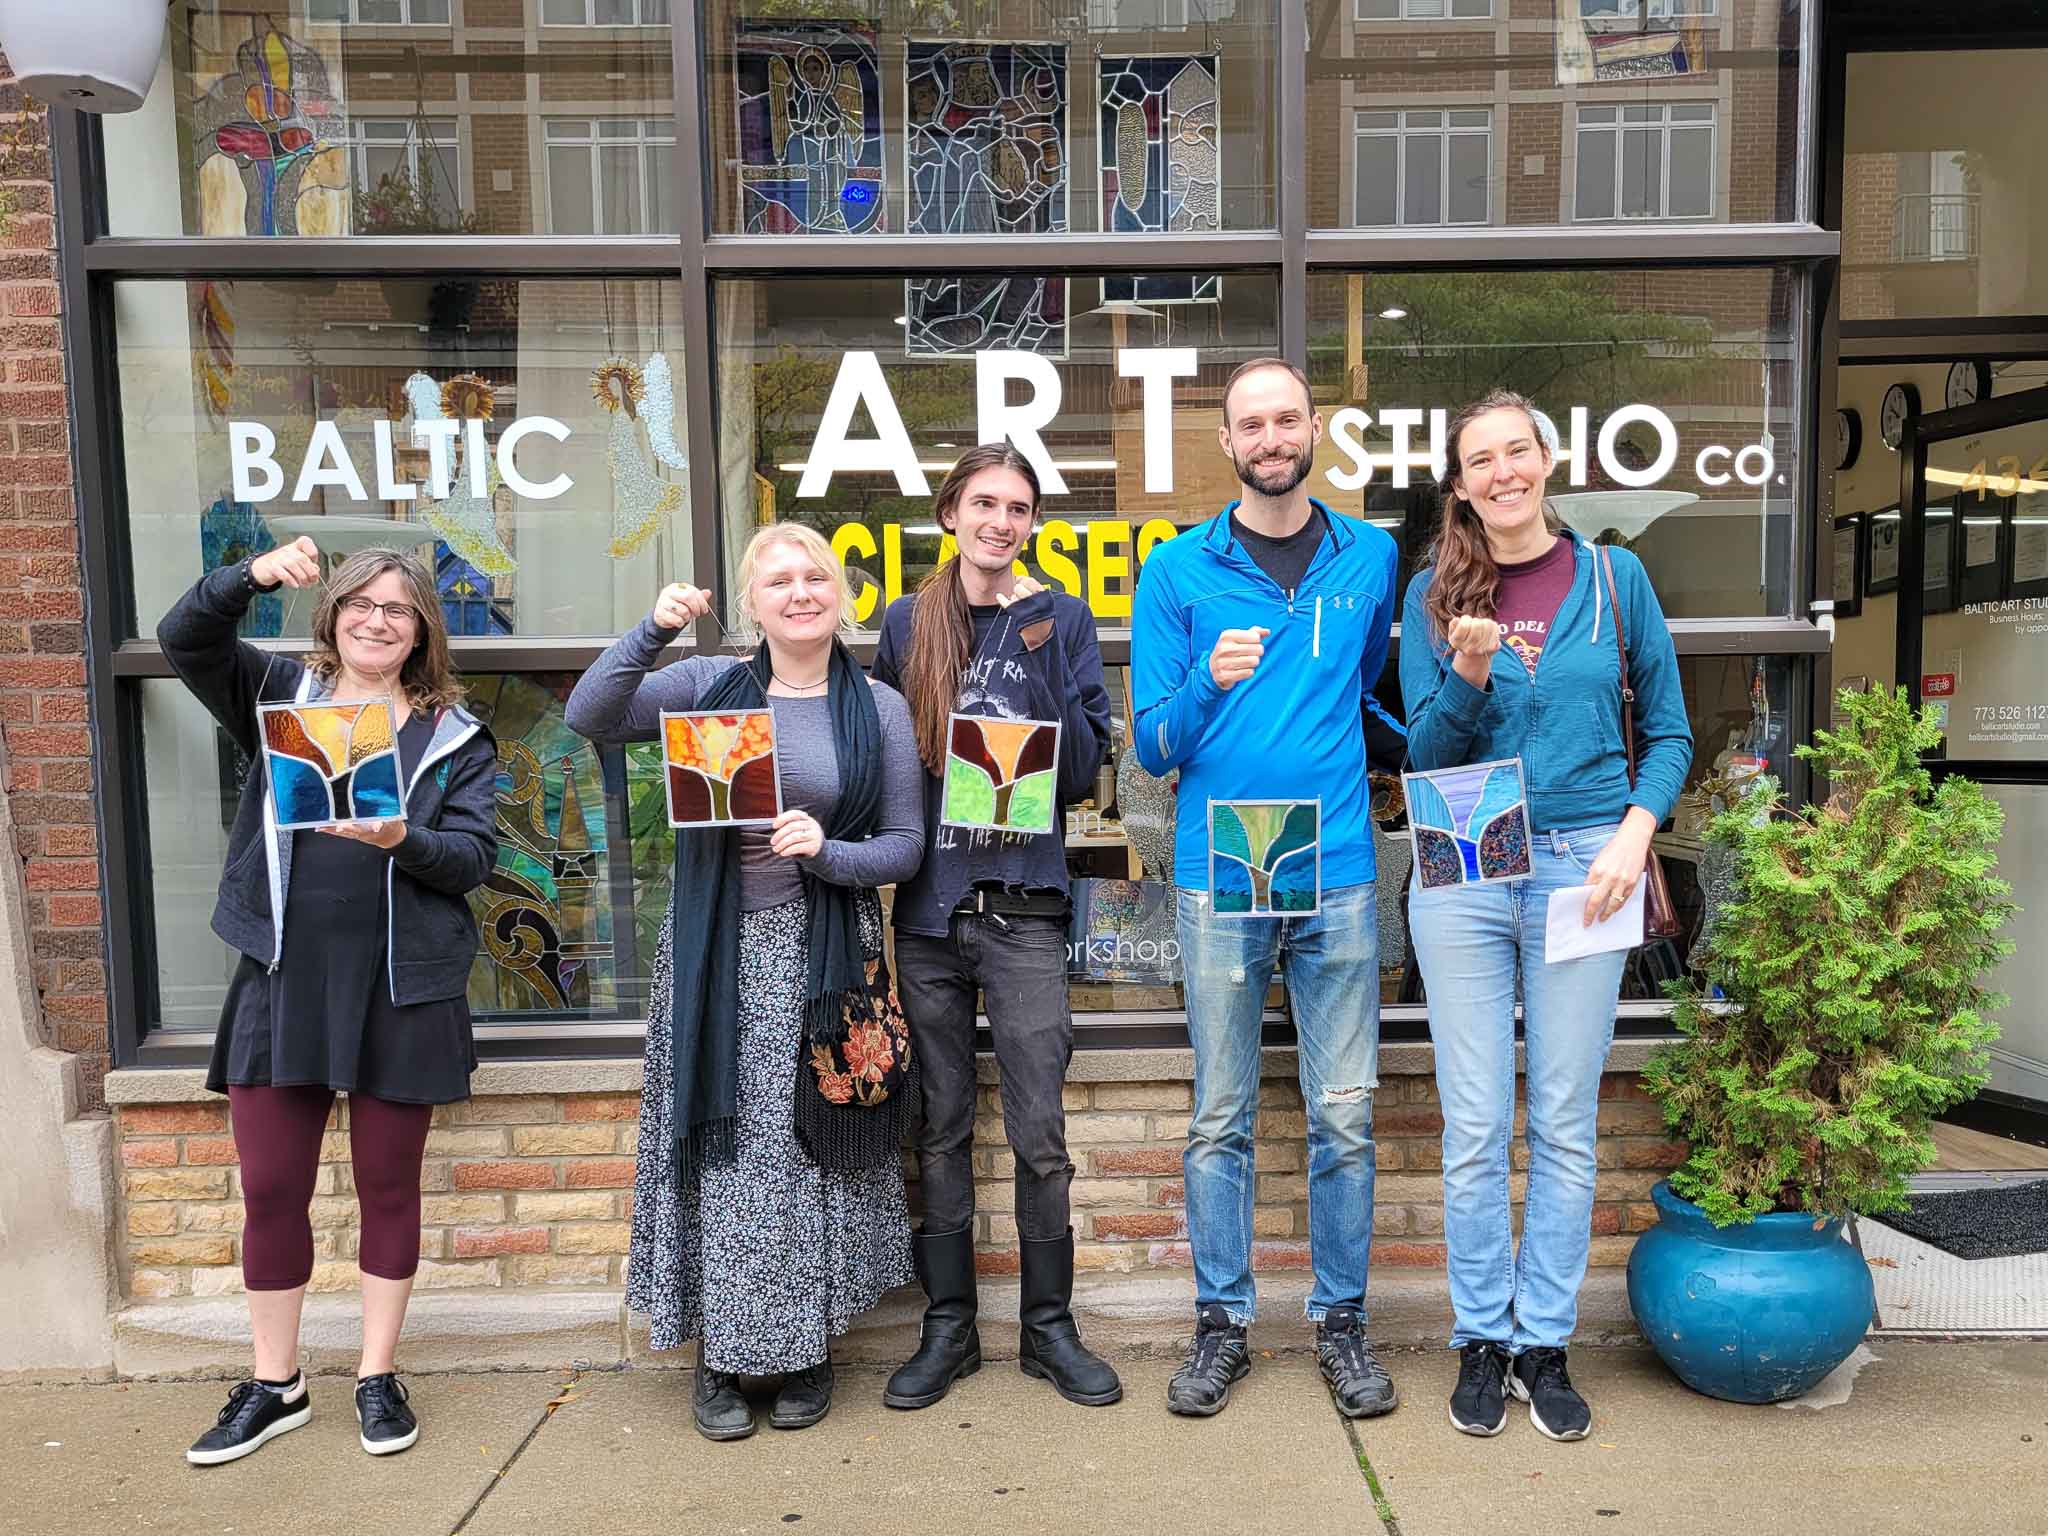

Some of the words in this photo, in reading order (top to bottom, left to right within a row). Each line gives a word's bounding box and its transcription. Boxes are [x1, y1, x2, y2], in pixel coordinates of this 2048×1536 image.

[229, 415, 575, 503] BALTIC
[796, 348, 1198, 498] ART
[1324, 404, 1678, 491] STIO
[831, 518, 1178, 622] CLSE
[1964, 601, 1999, 615] BALTIC
[2000, 599, 2021, 612] ART
[1513, 620, 1546, 633] DEL
[1989, 615, 2019, 624] Business
[2015, 625, 2025, 634] by
[1974, 706, 1995, 720] 773
[1999, 706, 2021, 720] 526
[2024, 704, 2048, 720] 112
[935, 826, 957, 855] ALL
[1066, 934, 1181, 968] rkshop
